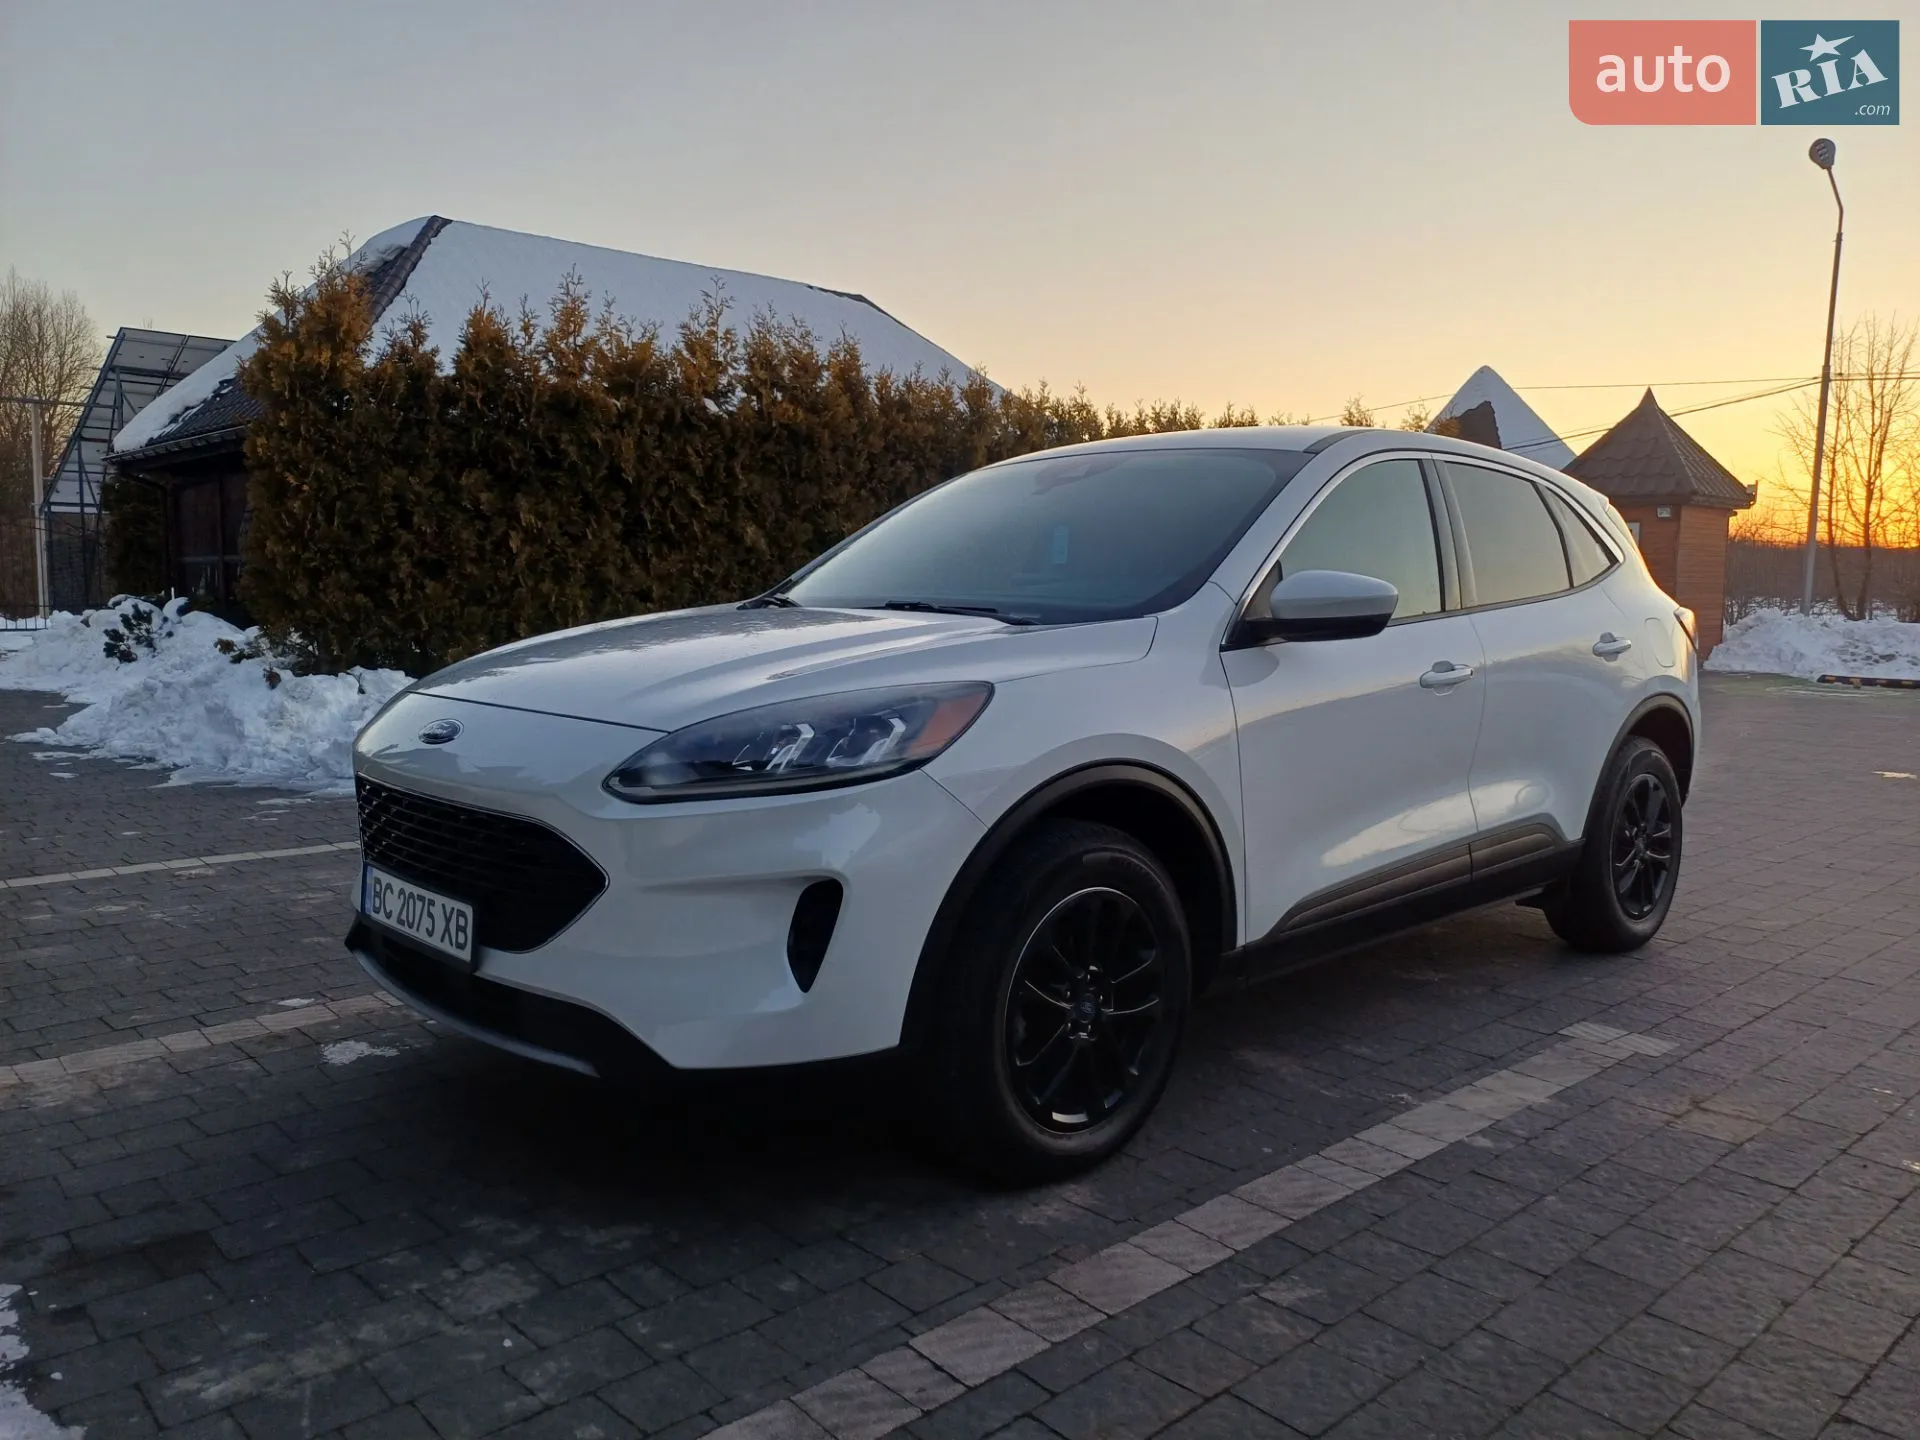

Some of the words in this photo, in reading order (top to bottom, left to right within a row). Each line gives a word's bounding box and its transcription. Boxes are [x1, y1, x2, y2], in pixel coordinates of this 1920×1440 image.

[372, 877, 394, 920] BC
[396, 887, 436, 938] 2075
[440, 903, 469, 950] XB
